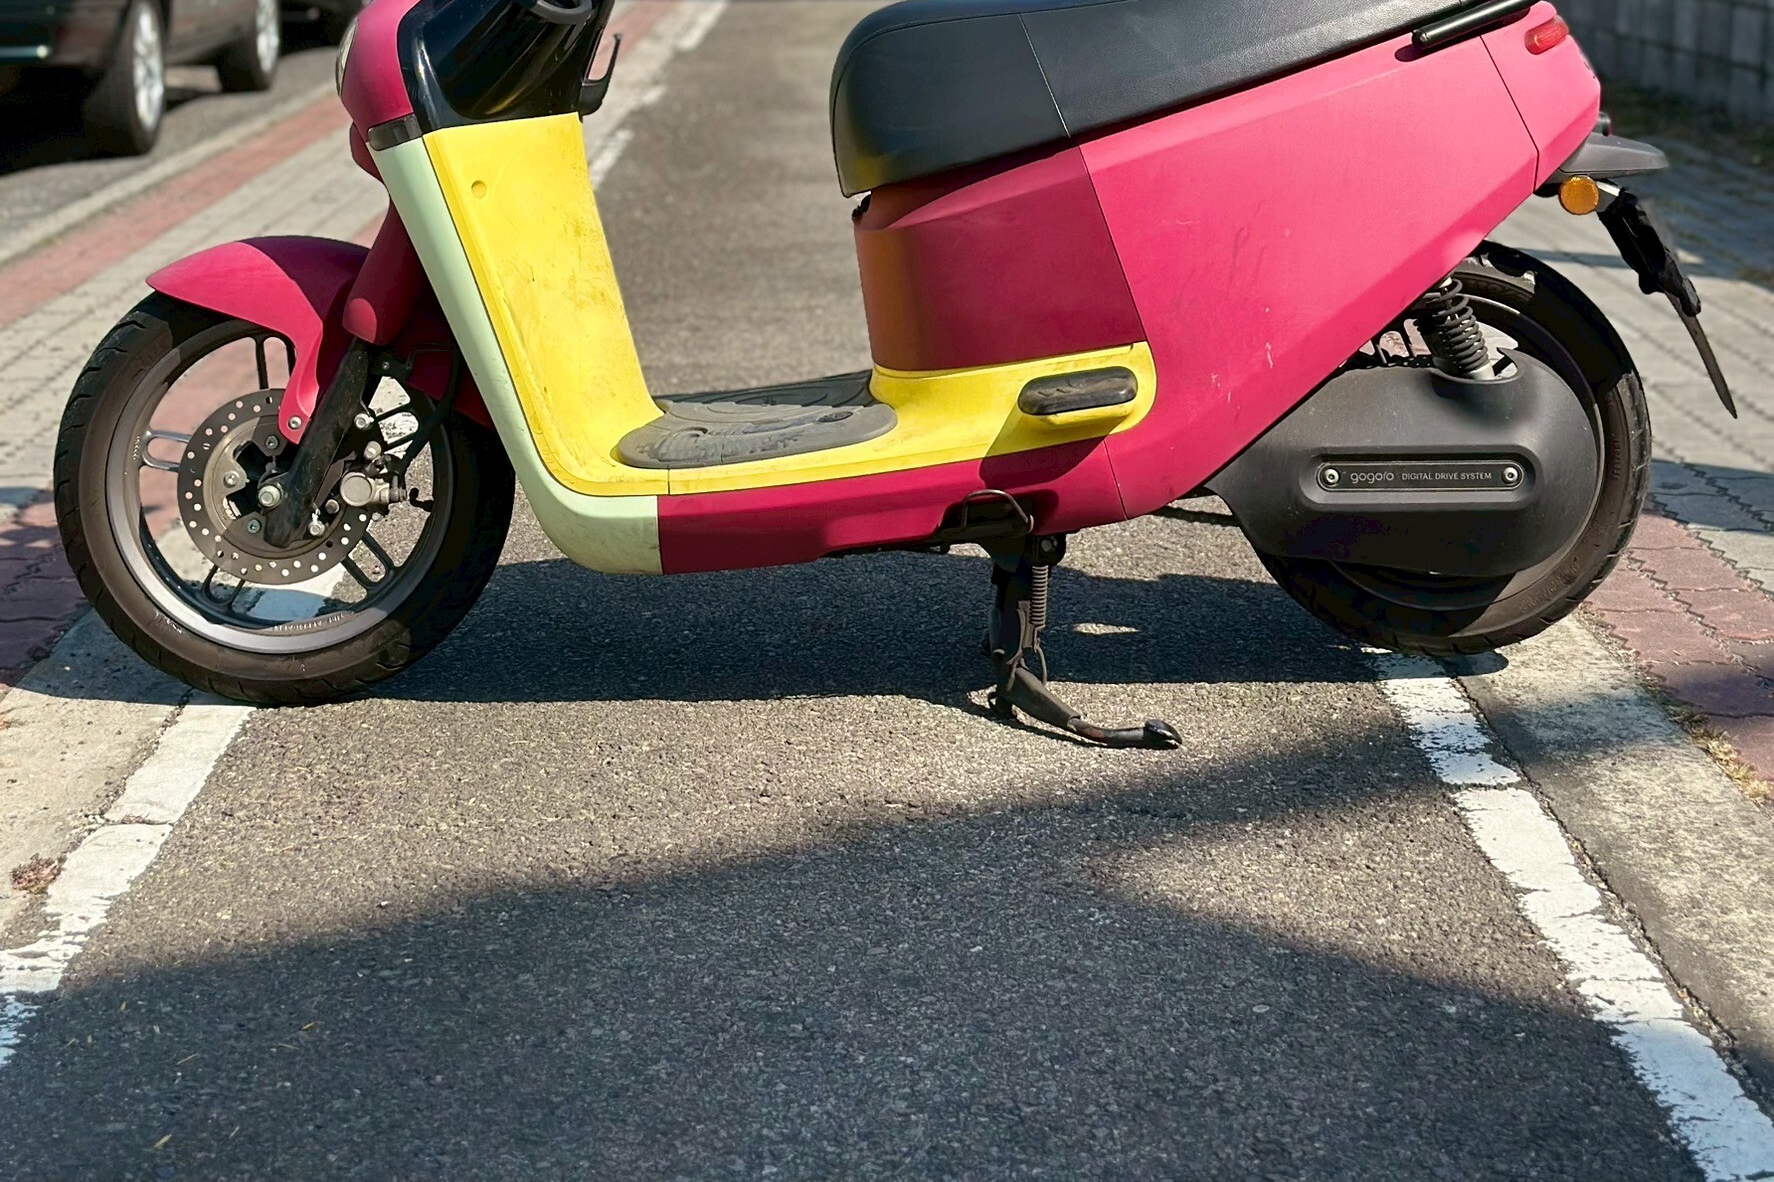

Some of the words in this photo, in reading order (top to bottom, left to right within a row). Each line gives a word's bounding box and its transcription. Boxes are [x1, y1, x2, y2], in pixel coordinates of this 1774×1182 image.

[1350, 471, 1395, 485] gogoro
[1401, 471, 1433, 481] DIGITAL
[1434, 471, 1459, 481] DRIVE
[1460, 471, 1493, 481] SYSTEM
